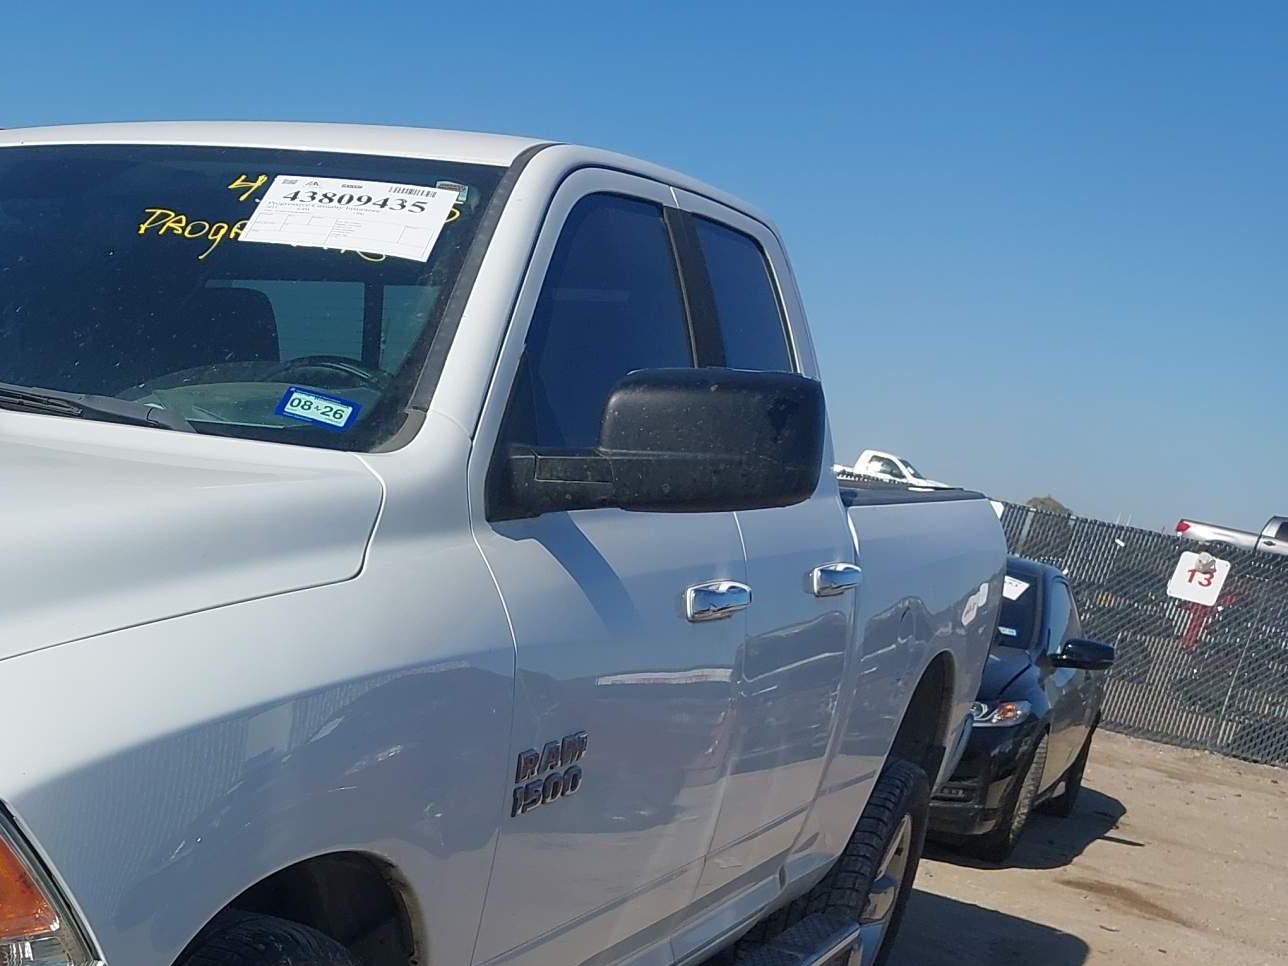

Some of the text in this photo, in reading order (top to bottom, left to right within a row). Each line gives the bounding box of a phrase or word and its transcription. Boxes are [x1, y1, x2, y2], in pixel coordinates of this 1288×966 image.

[283, 190, 428, 214] 43809435
[514, 730, 589, 784] RAM
[511, 764, 583, 818] 1500
